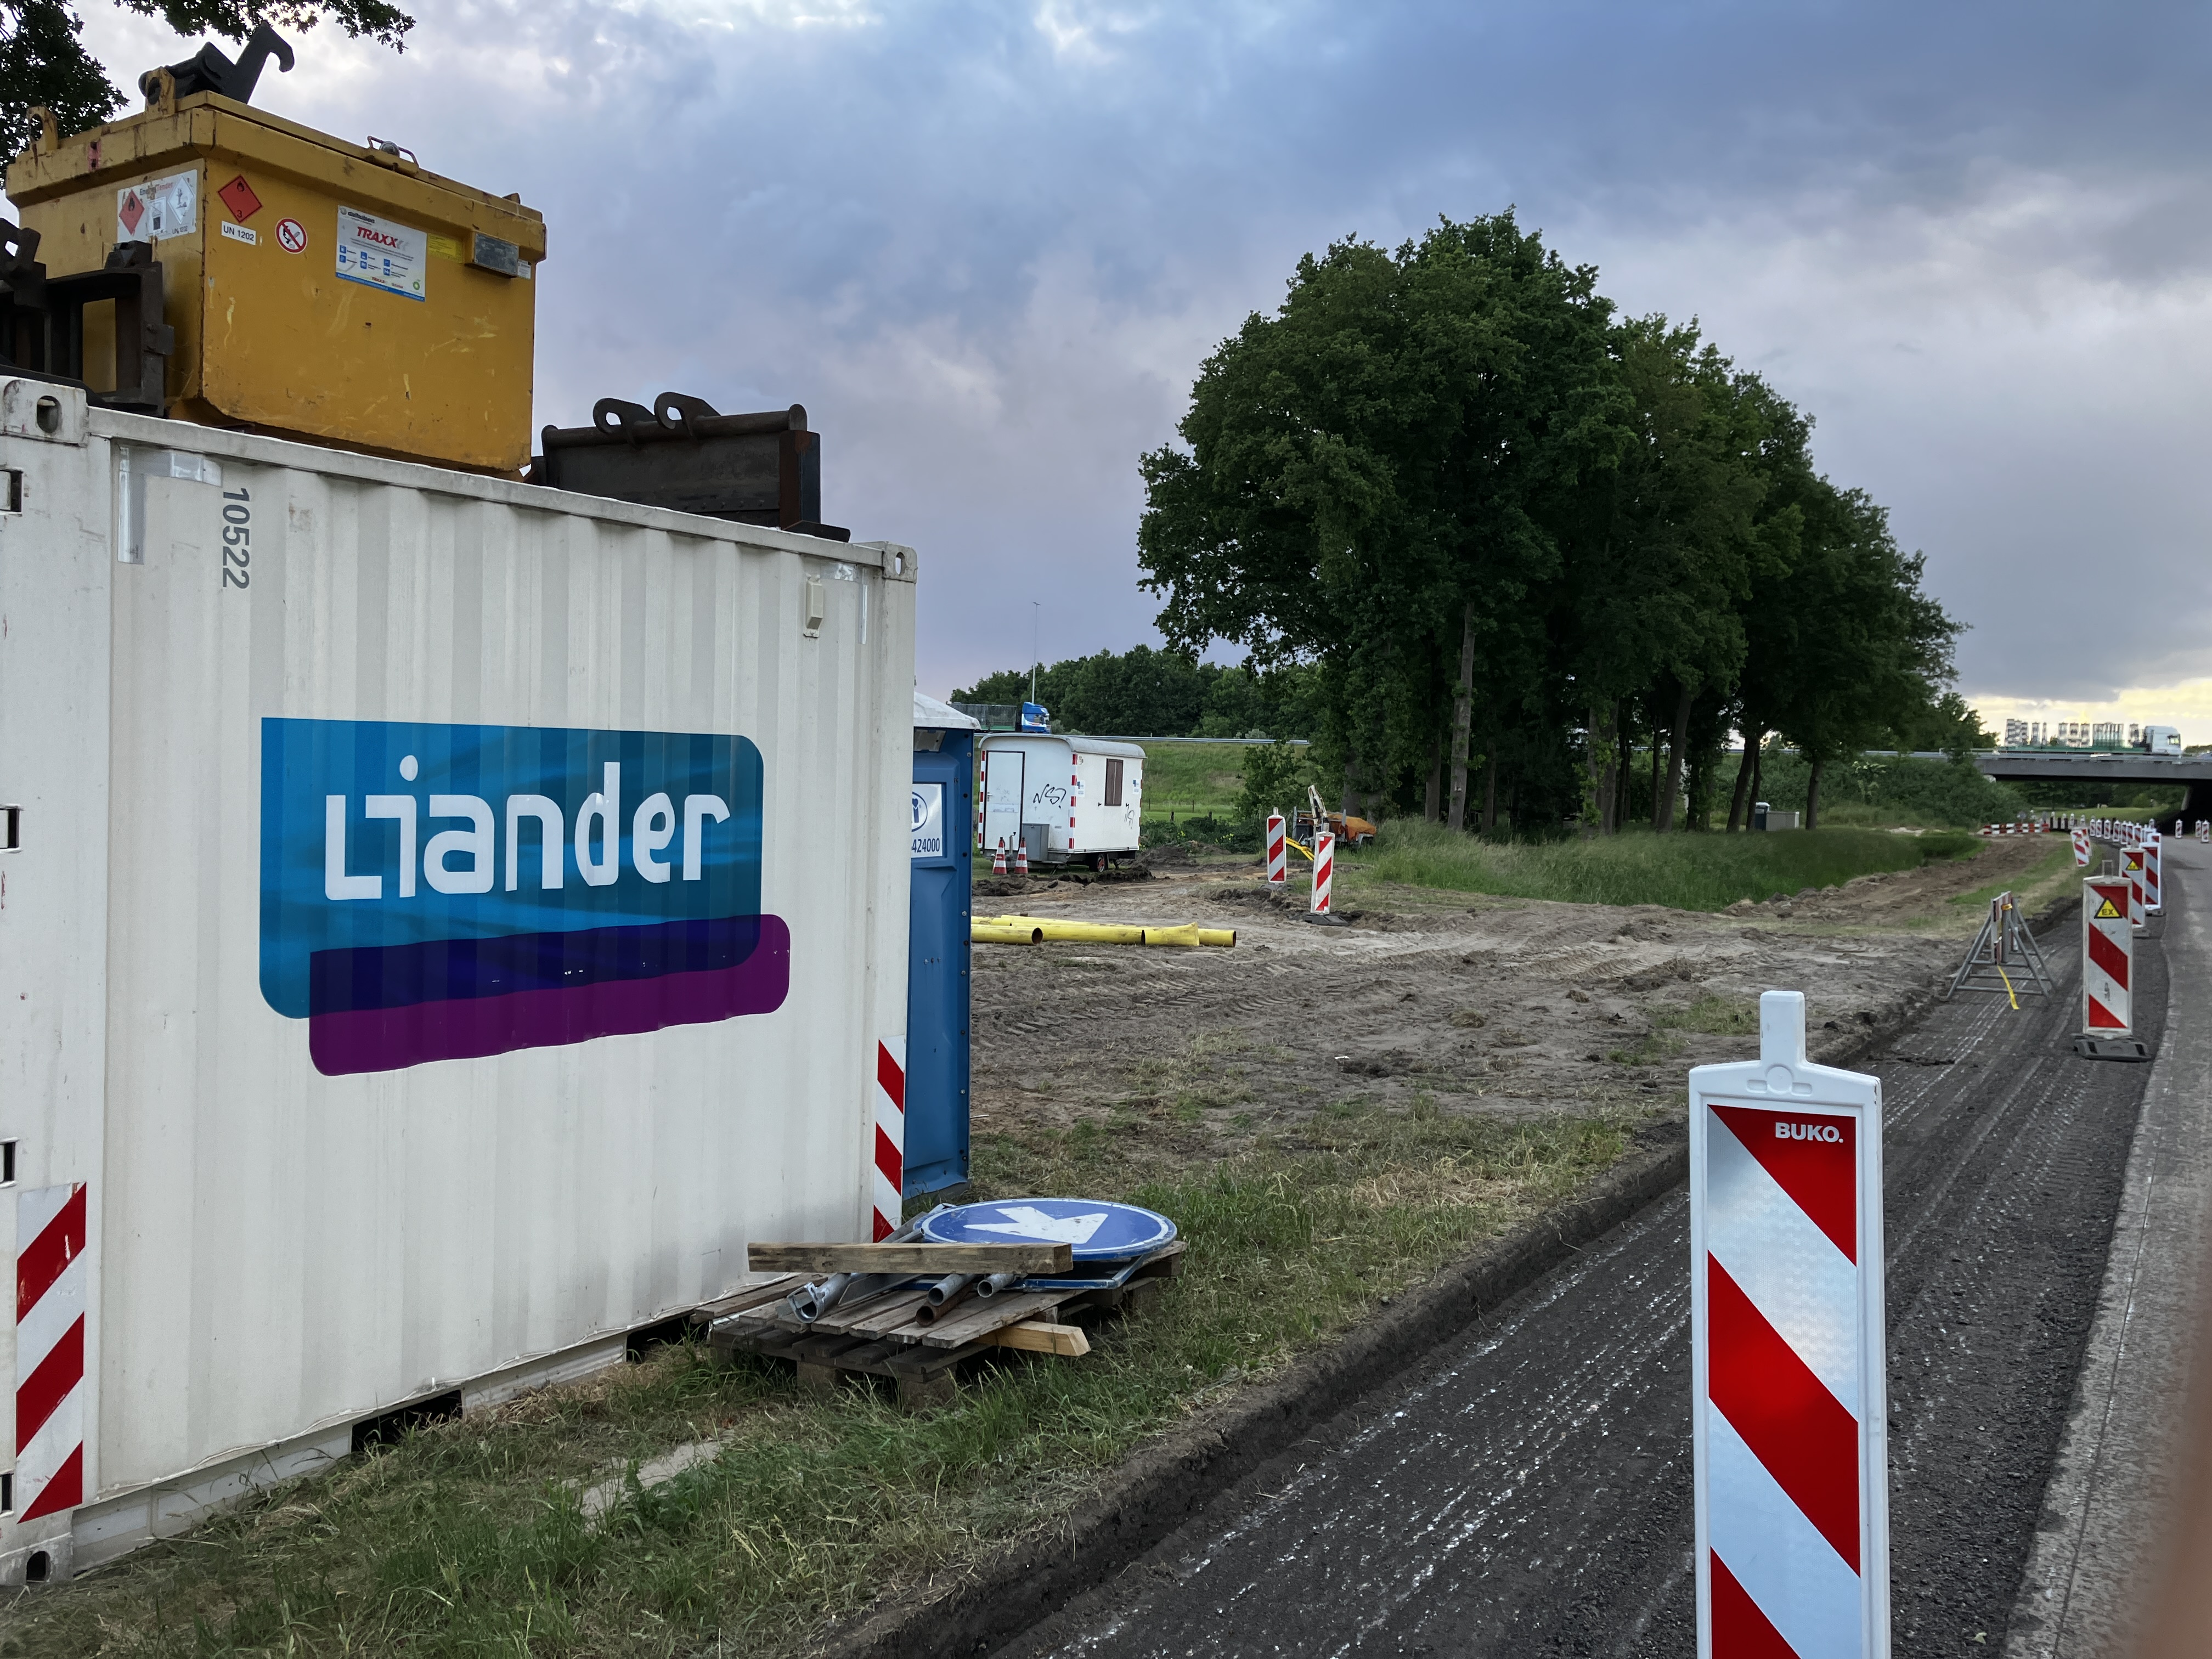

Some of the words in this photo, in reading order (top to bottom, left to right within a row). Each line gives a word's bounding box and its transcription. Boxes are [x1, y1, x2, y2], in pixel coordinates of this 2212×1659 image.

[237, 210, 242, 218] 3
[223, 225, 235, 235] UN
[238, 230, 254, 241] 1202
[357, 226, 398, 248] TRAXX
[222, 488, 250, 589] 10522
[325, 755, 730, 901] Liander
